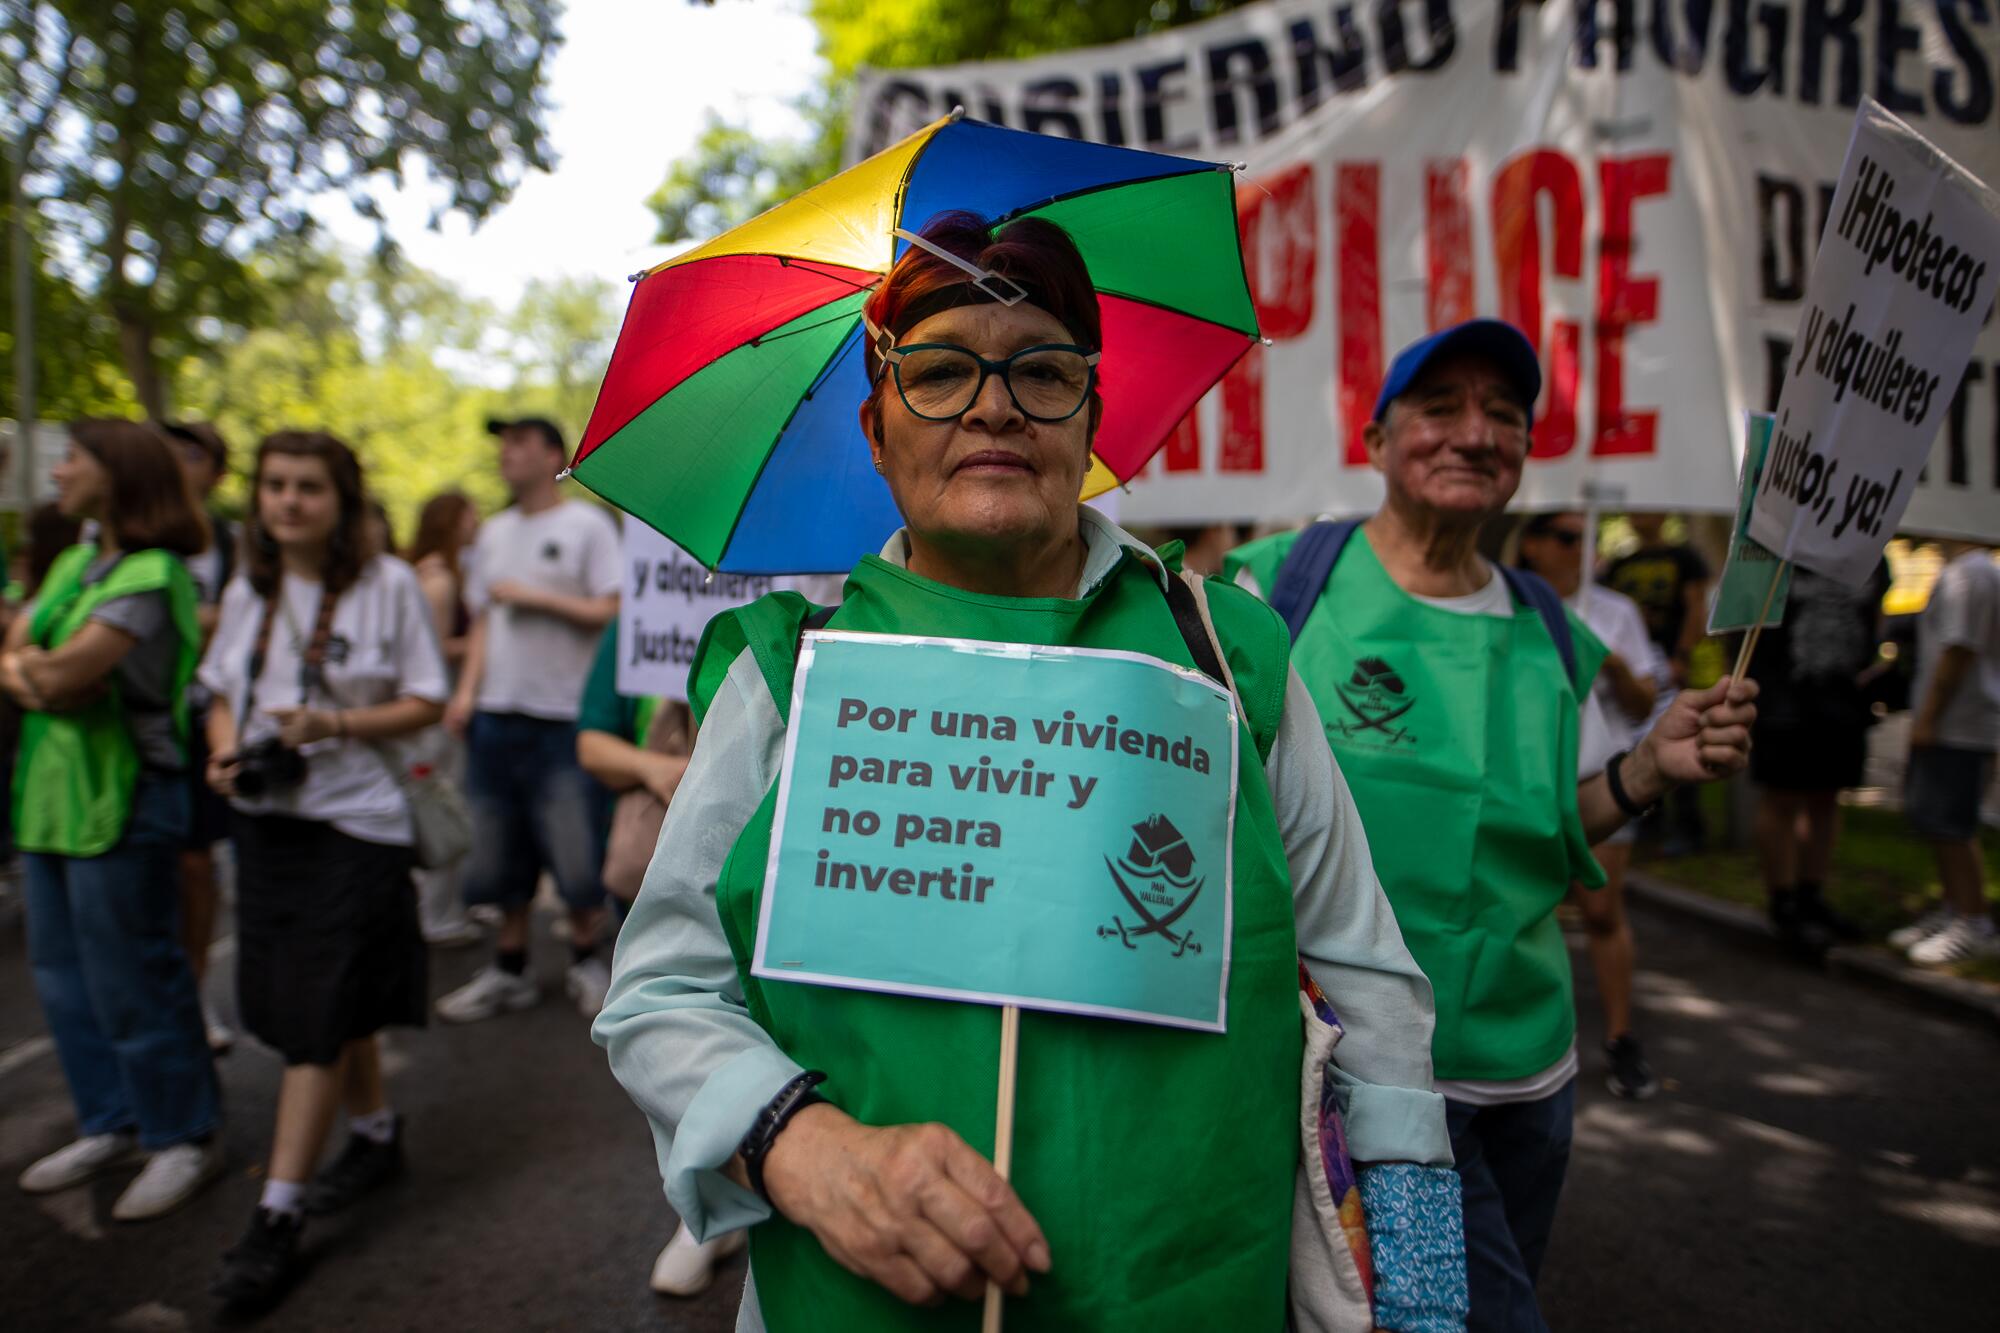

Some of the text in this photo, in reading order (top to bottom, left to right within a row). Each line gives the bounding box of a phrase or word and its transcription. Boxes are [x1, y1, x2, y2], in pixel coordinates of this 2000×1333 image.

[1837, 156, 1987, 315] ¡Hipotecas
[1141, 148, 1673, 480] PLICE
[1794, 304, 1825, 378] y
[1814, 302, 1941, 428] alquileres
[1762, 408, 1838, 527] justos,
[1831, 467, 1904, 541] ya!
[633, 558, 649, 598] y
[837, 698, 1211, 777] Por una vivienda
[828, 755, 1099, 810] para vivir y
[822, 807, 1002, 848] no para
[814, 849, 994, 903] invertir
